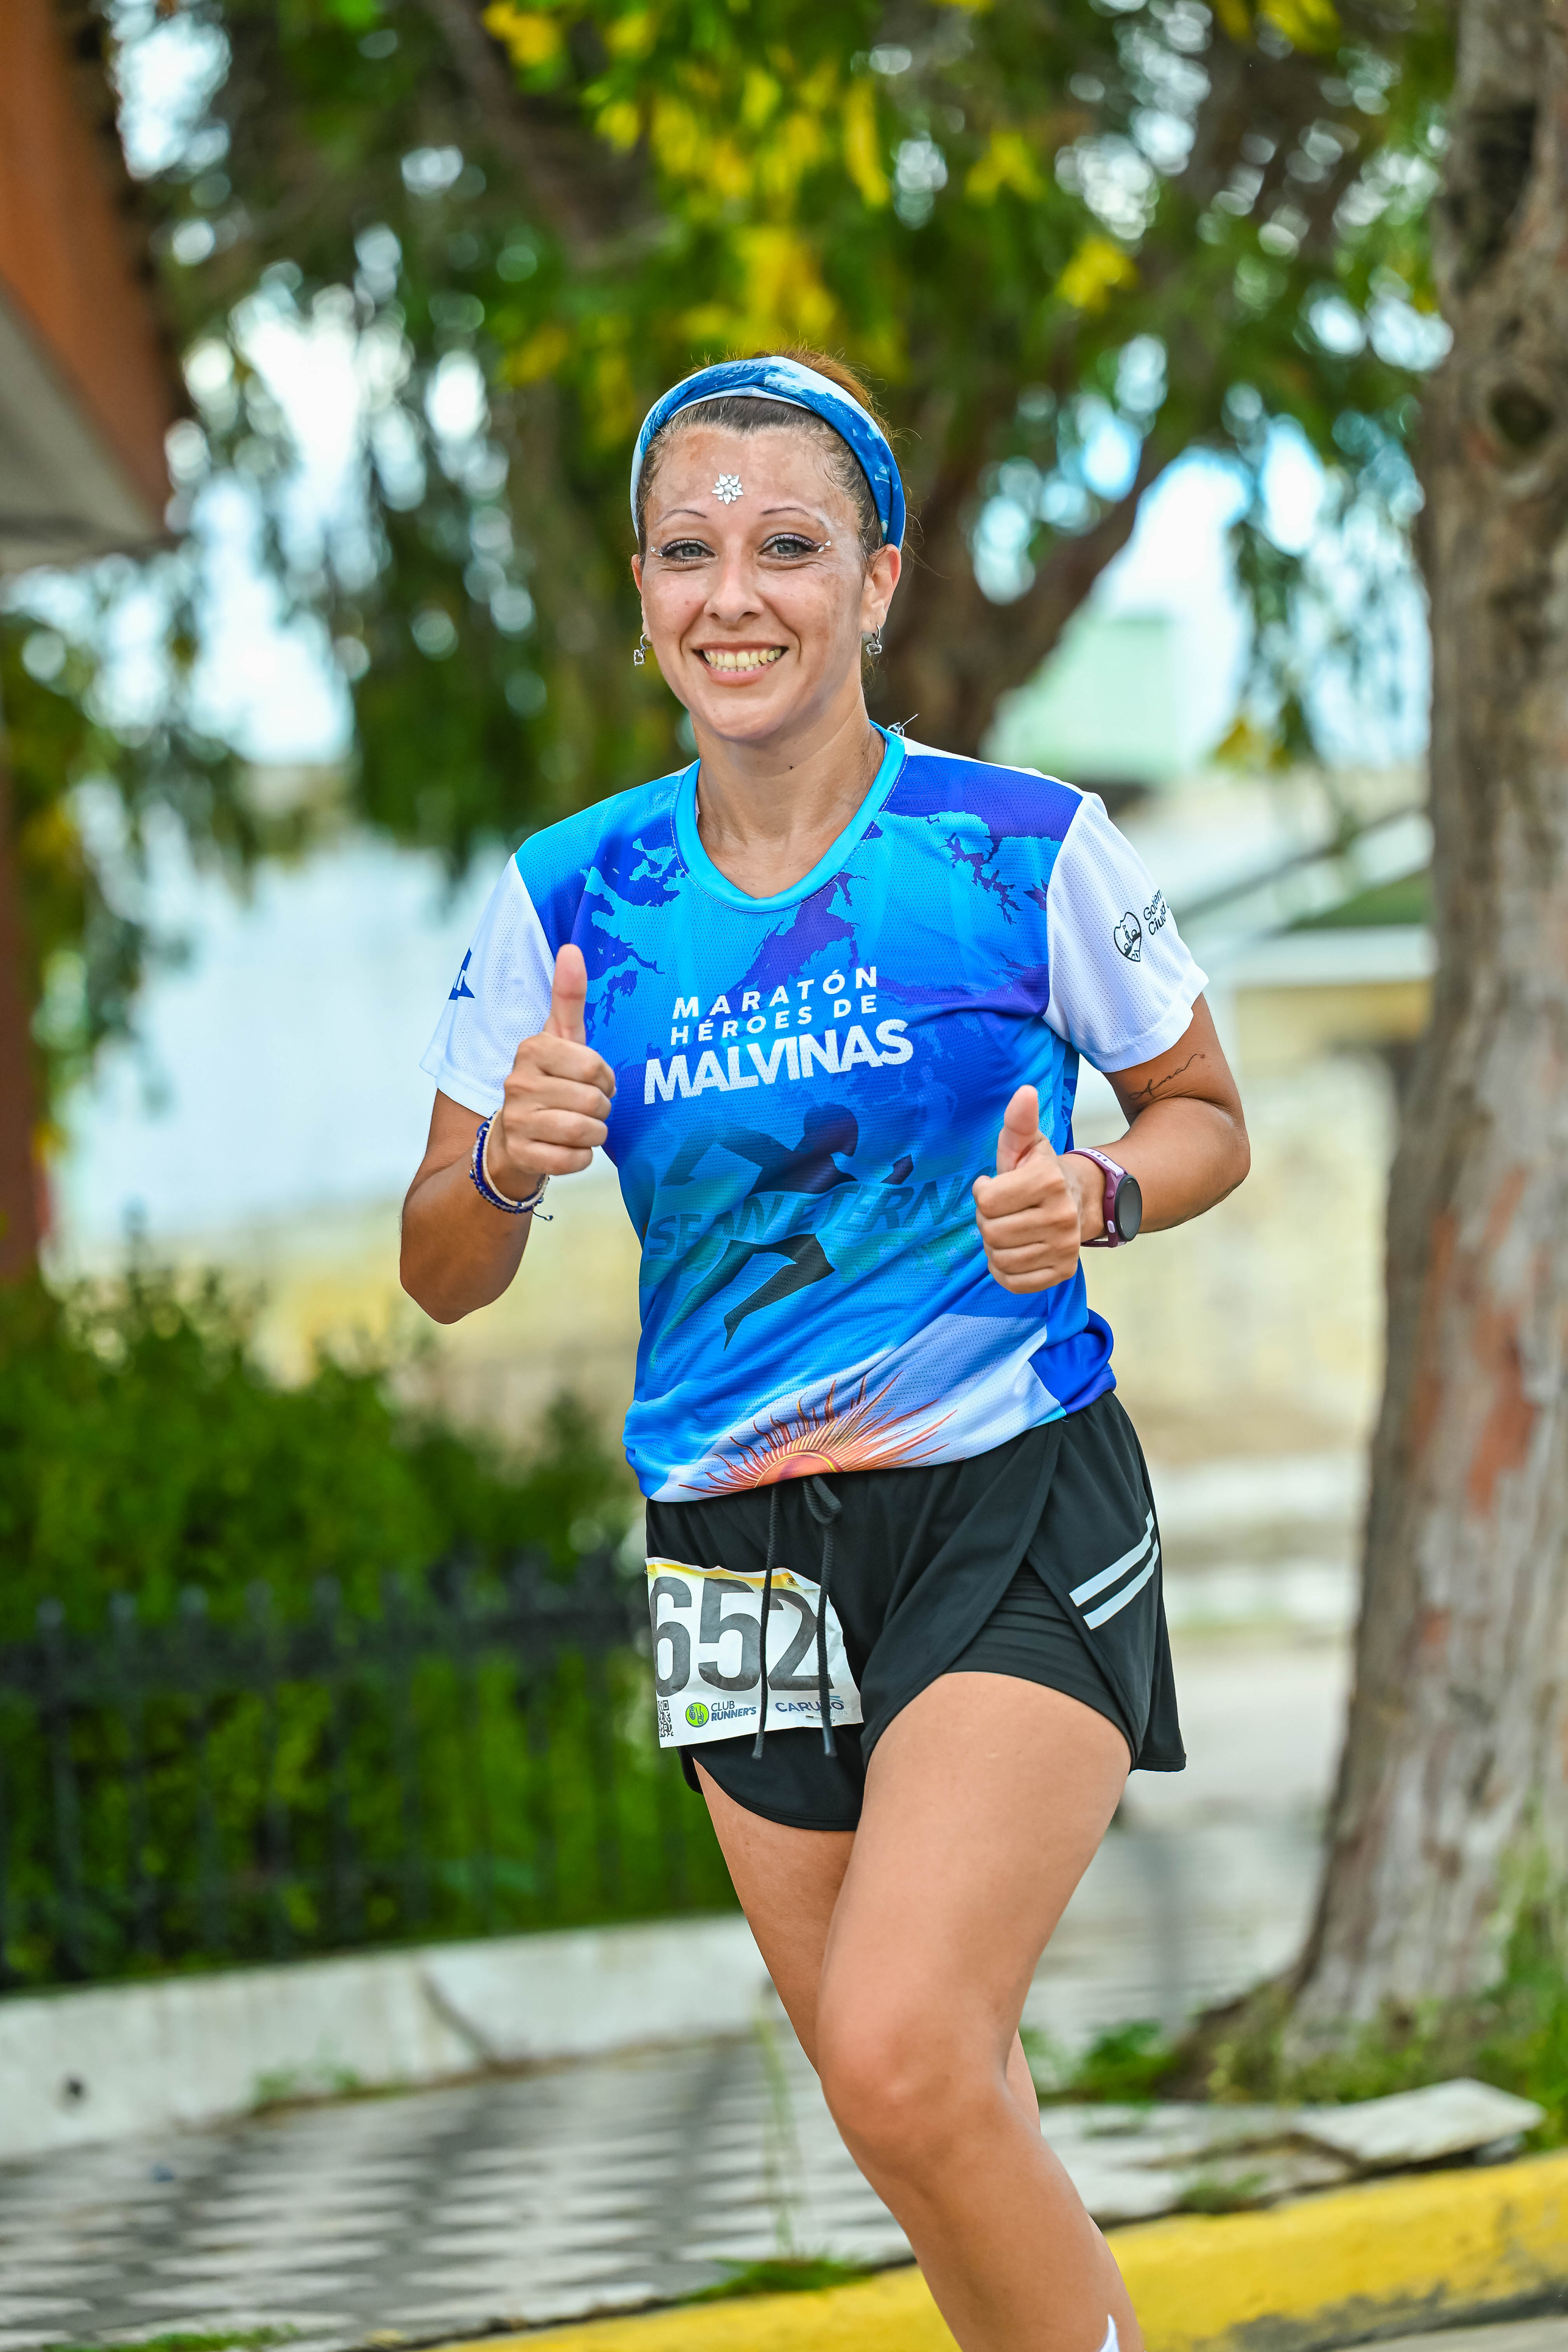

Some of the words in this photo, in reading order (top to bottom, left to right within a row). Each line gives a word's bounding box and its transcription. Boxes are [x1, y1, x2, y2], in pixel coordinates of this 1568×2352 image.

[672, 967, 877, 1020] MARATÓN
[670, 1006, 813, 1045] HÉROES
[833, 994, 877, 1018] DE
[644, 1018, 914, 1105] MALVINAS
[650, 1576, 835, 1697] 652
[711, 1700, 735, 1712] CLUB
[711, 1706, 757, 1721] RUNNER'S
[775, 1701, 844, 1712] CARUO
